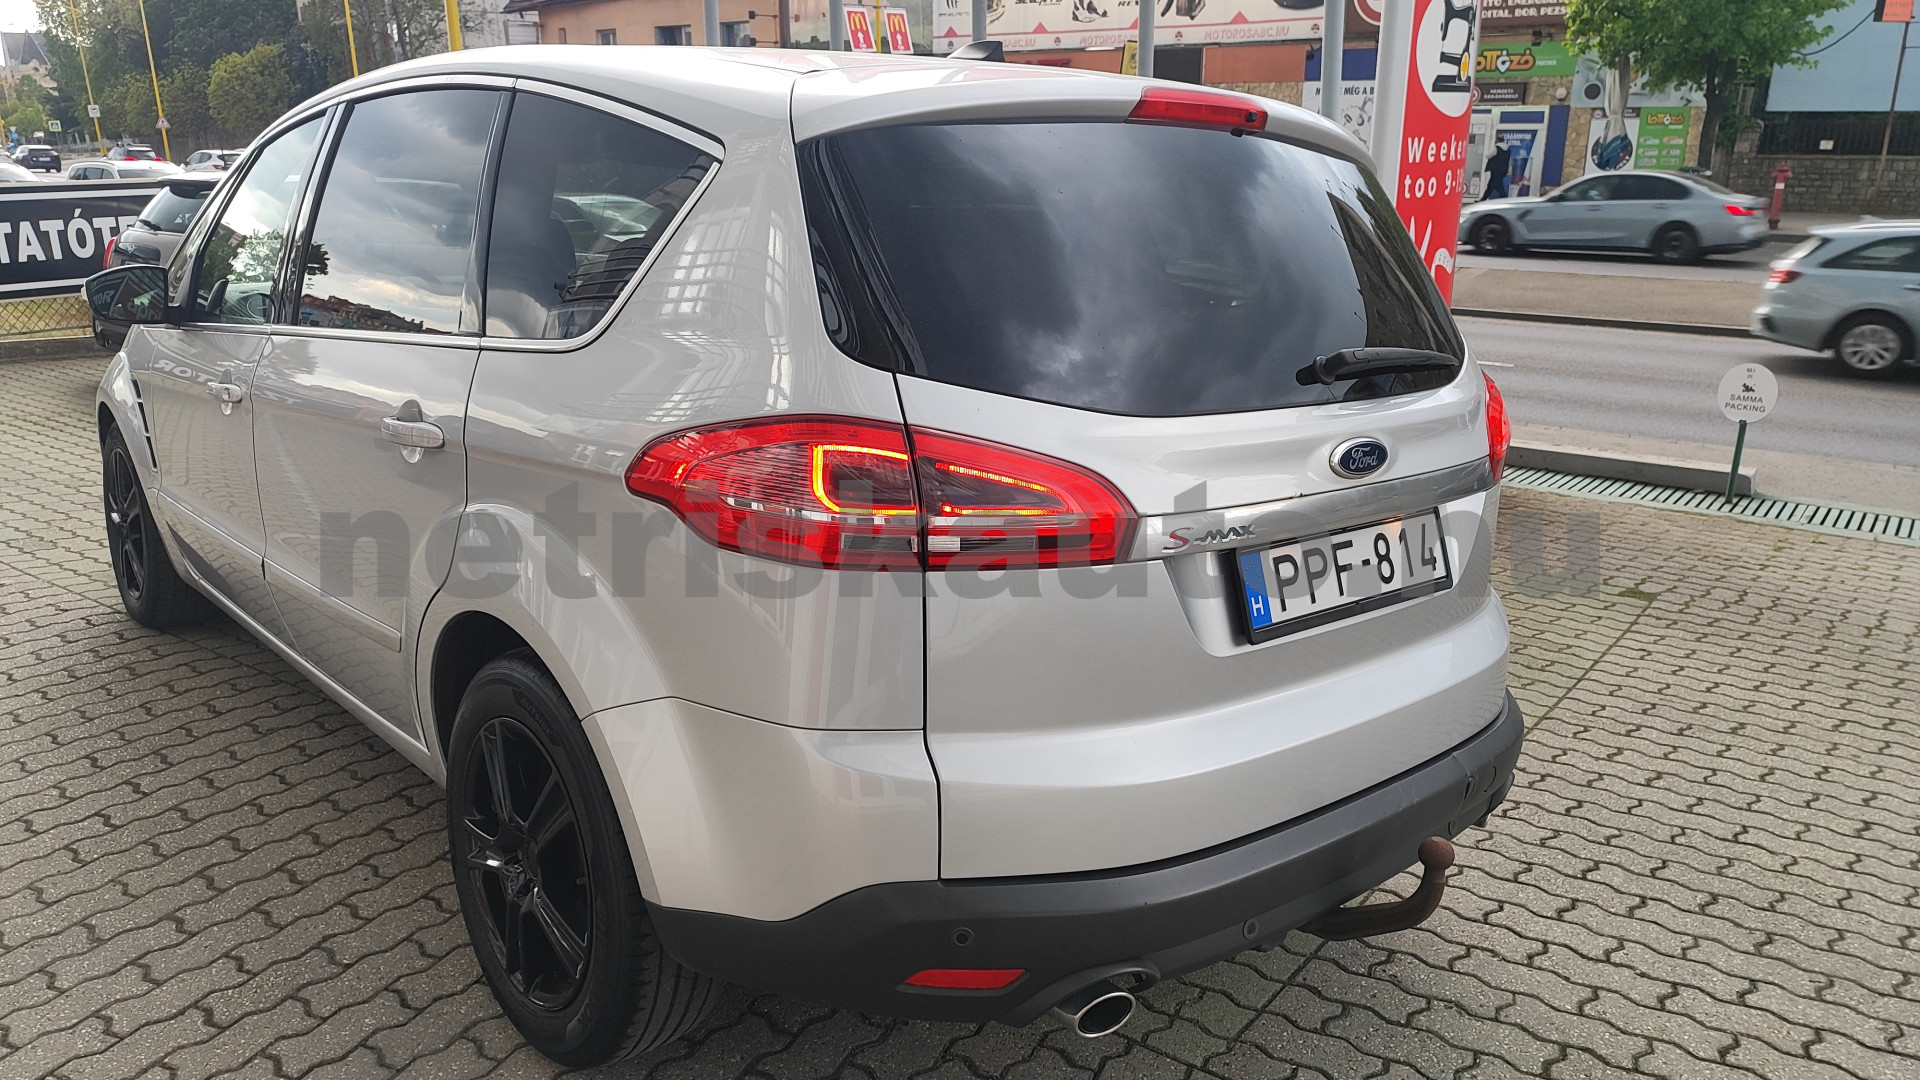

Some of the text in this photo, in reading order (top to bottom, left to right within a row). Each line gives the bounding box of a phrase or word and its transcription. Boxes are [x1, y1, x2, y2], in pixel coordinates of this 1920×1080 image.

[1343, 84, 1360, 96] MÉG
[1404, 173, 1438, 200] too
[1724, 402, 1767, 413] PACKING
[1729, 393, 1764, 404] SAMMA
[1349, 446, 1379, 470] Ford
[1161, 524, 1257, 553] S-MAX
[1272, 523, 1437, 612] PPF-814
[519, 698, 553, 736] OUTSIDE
